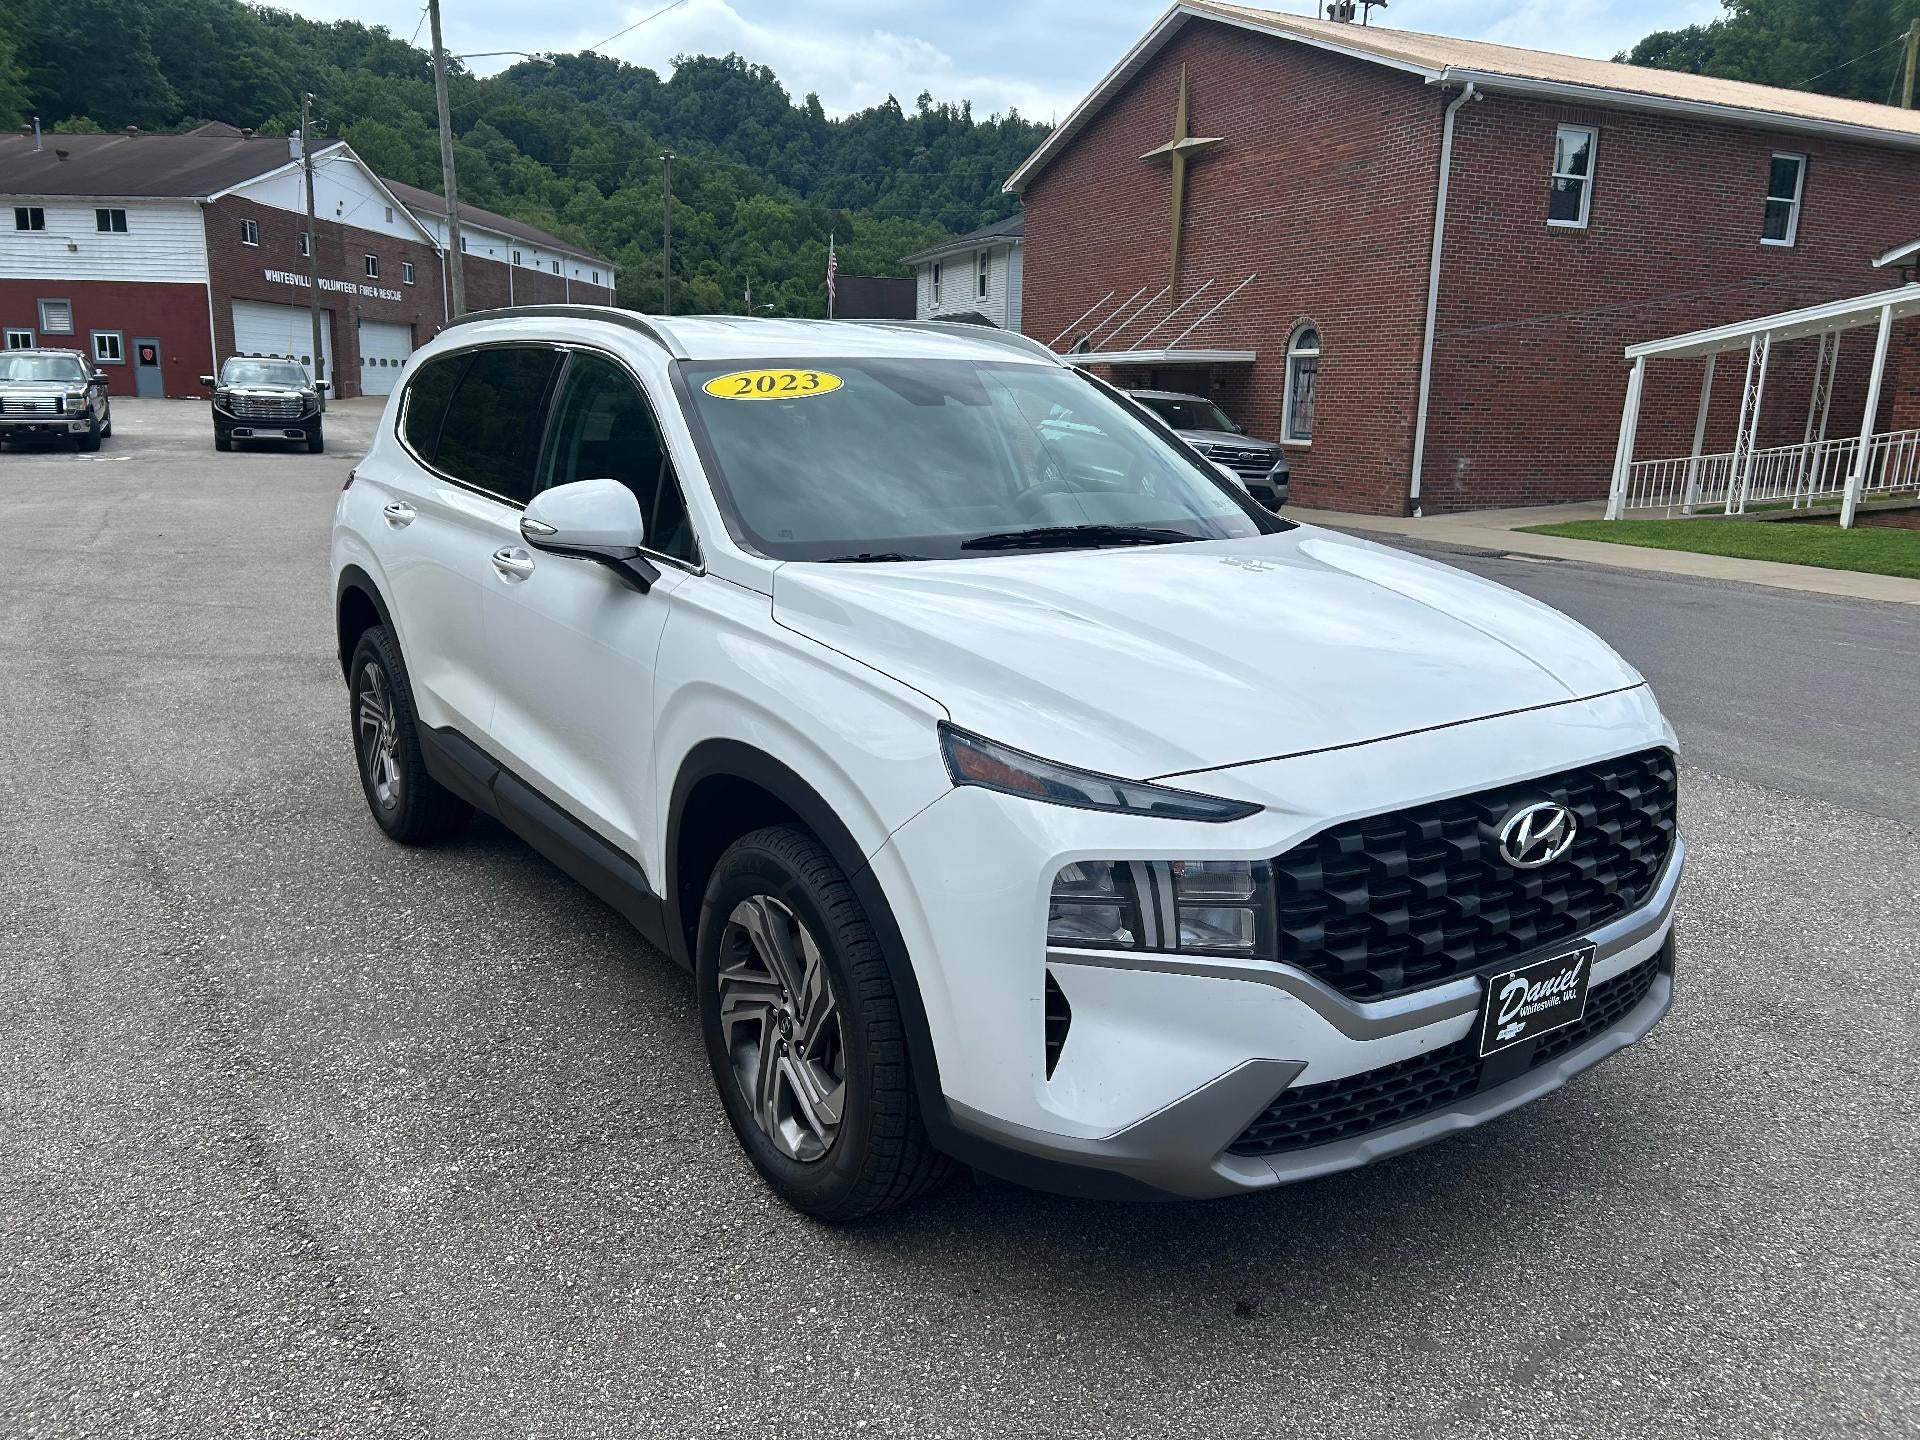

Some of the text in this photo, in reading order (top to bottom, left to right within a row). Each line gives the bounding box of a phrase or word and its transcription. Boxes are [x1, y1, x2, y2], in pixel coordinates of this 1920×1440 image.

[264, 269, 311, 288] WHITESVILL
[317, 278, 357, 294] VOLUNTEER
[359, 285, 373, 297] FIRE
[379, 288, 402, 302] RESCUE
[734, 373, 820, 396] 2023
[1498, 956, 1585, 1026] Daniel
